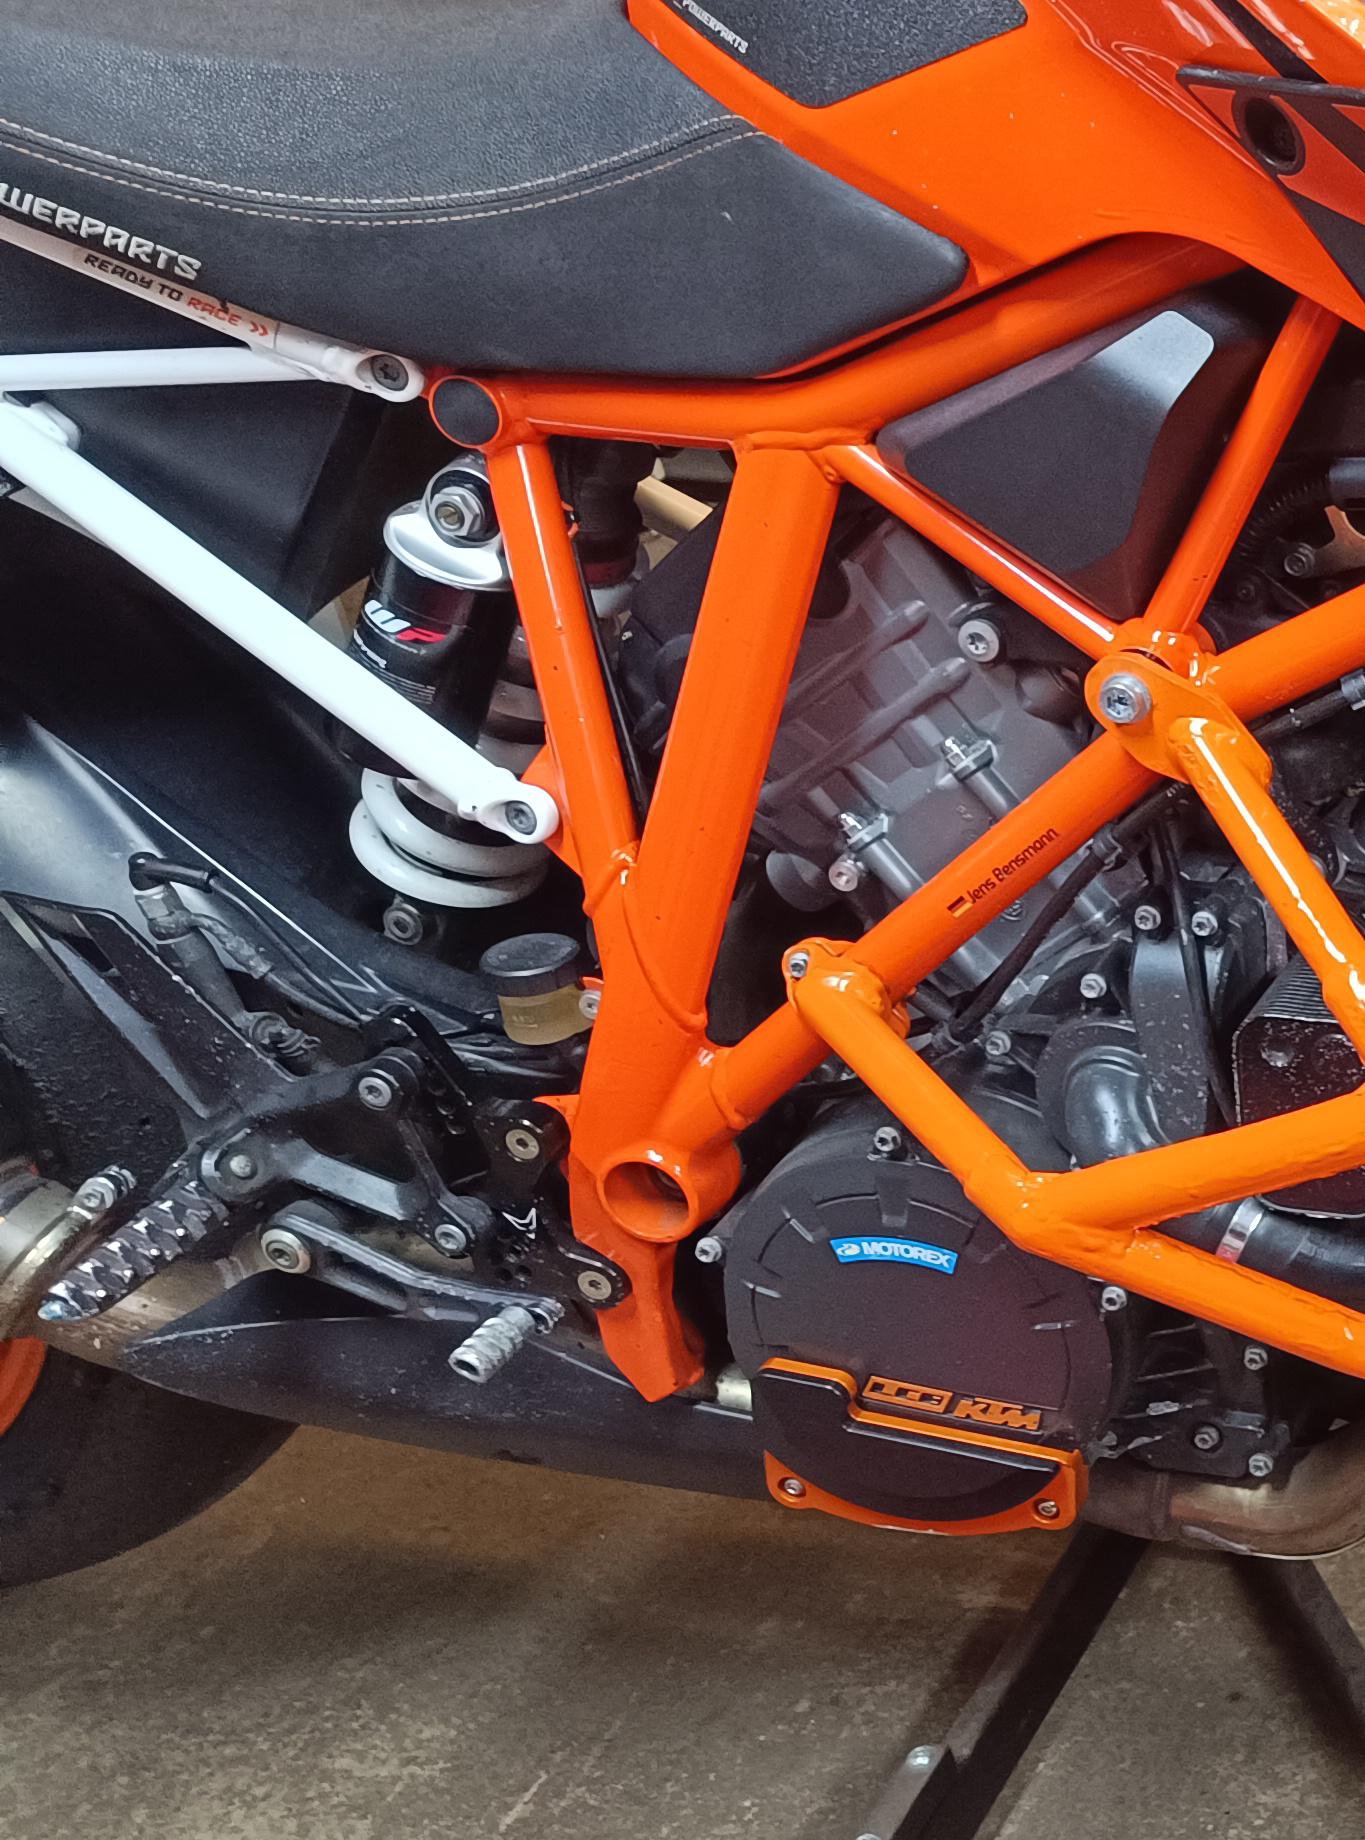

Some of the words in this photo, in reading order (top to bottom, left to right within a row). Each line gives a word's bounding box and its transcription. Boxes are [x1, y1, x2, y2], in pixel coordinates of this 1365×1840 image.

[0, 182, 202, 281] WERPARTS
[84, 253, 153, 289] READY
[158, 283, 183, 301] TO
[187, 296, 242, 326] RACE
[966, 878, 997, 904] Jens
[991, 828, 1061, 882] Bensmann
[861, 1241, 951, 1268] MOTOREX
[953, 1396, 1042, 1431] KTM
